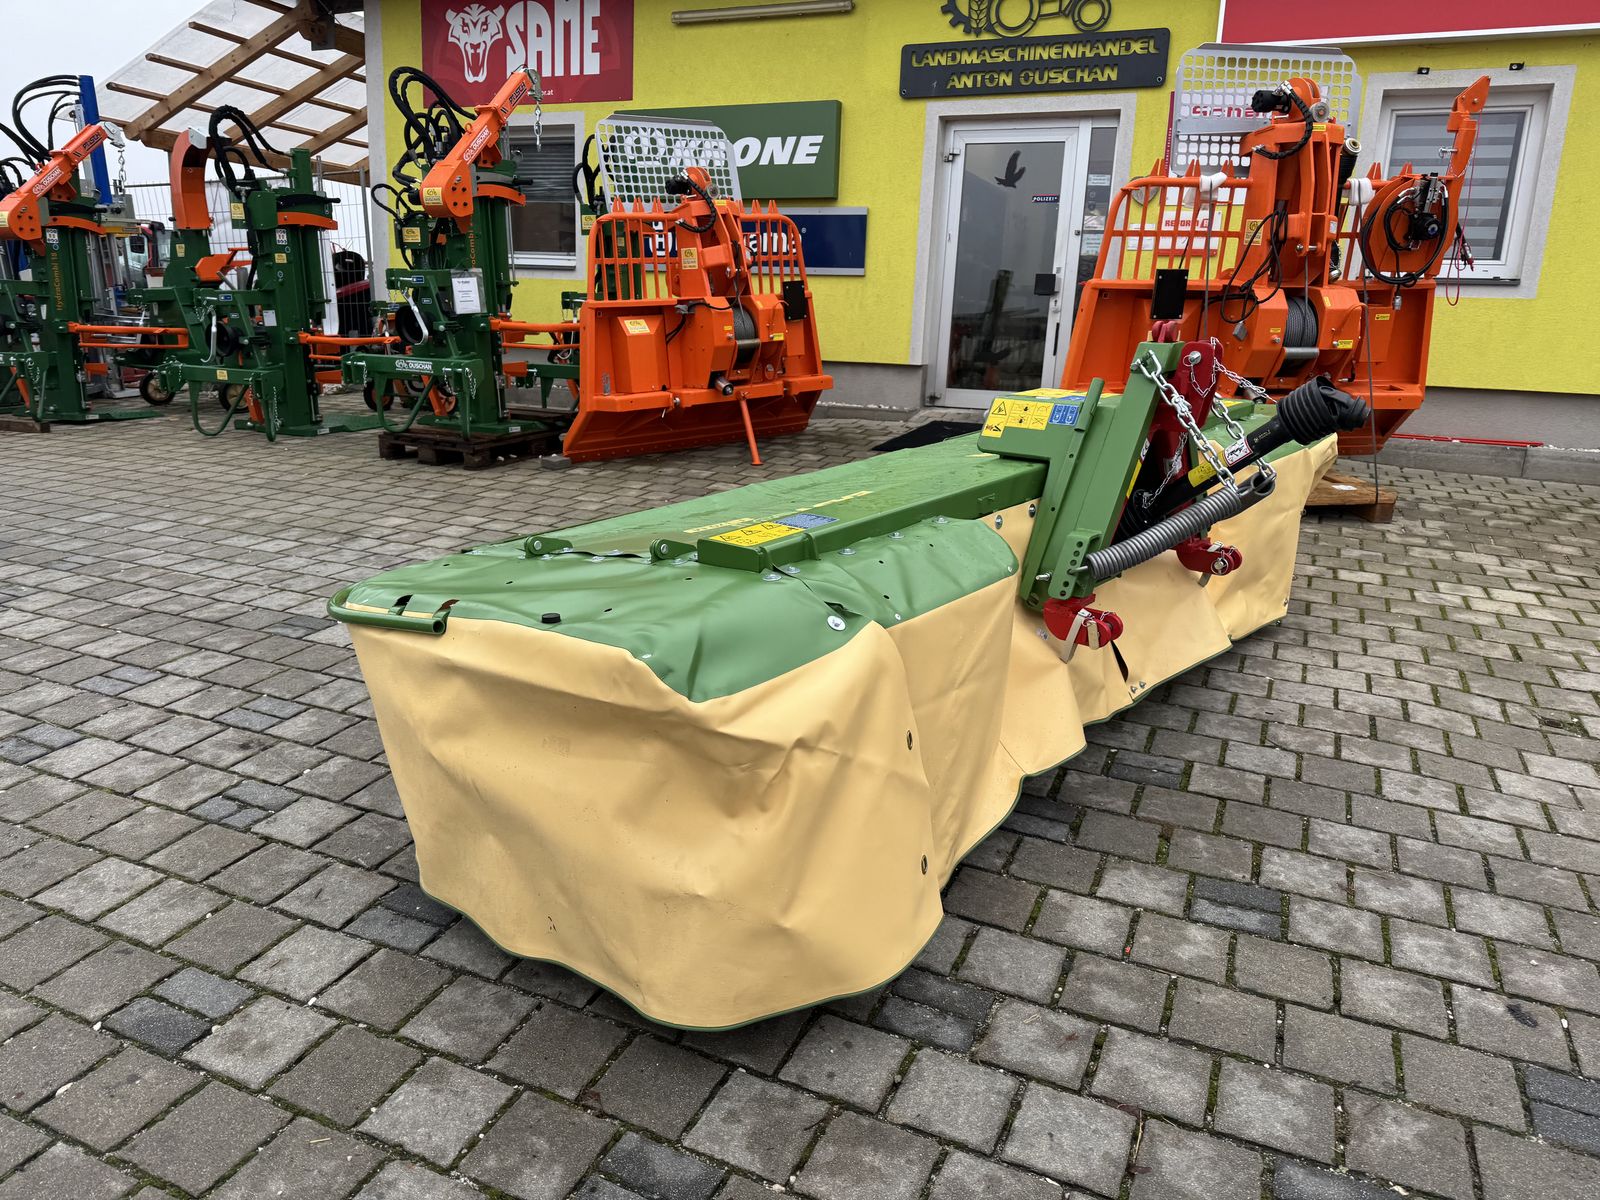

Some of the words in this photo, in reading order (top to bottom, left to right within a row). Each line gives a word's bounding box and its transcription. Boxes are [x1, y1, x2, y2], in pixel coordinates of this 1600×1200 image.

[505, 0, 600, 78] SAME
[911, 35, 1160, 68] LANDMASCHINENHANDEL
[946, 69, 1013, 89] ANTON
[1019, 64, 1118, 86] OUSCHAN
[669, 135, 824, 168] KRONE
[1164, 219, 1200, 227] REOR
[409, 362, 432, 370] OUSCHAN
